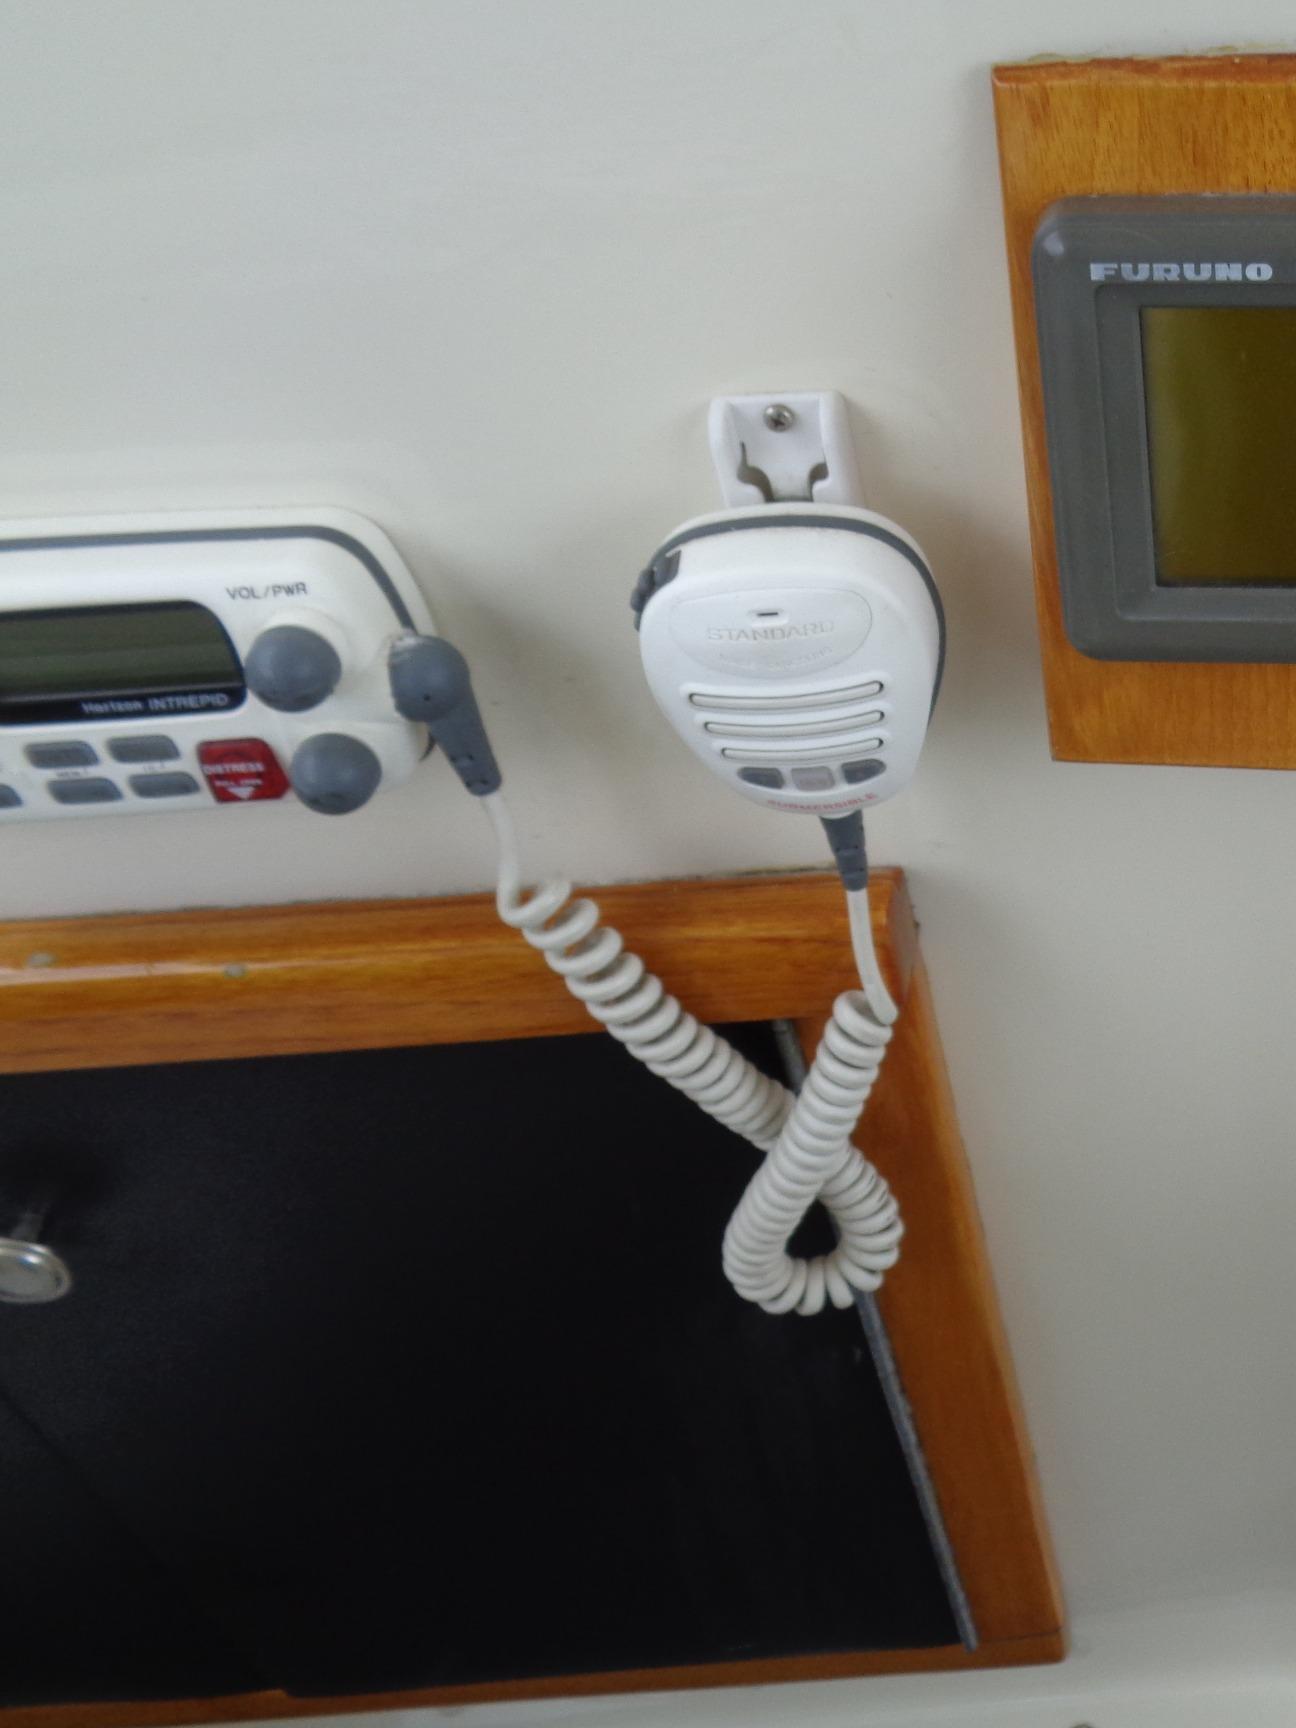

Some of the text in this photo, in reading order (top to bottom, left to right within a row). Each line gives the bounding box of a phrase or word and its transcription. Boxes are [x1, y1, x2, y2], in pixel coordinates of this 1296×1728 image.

[1089, 263, 1273, 281] FURUNO
[225, 582, 308, 600] VOL/PWR
[707, 621, 833, 641] STANDARD
[147, 693, 229, 710] INTREPID
